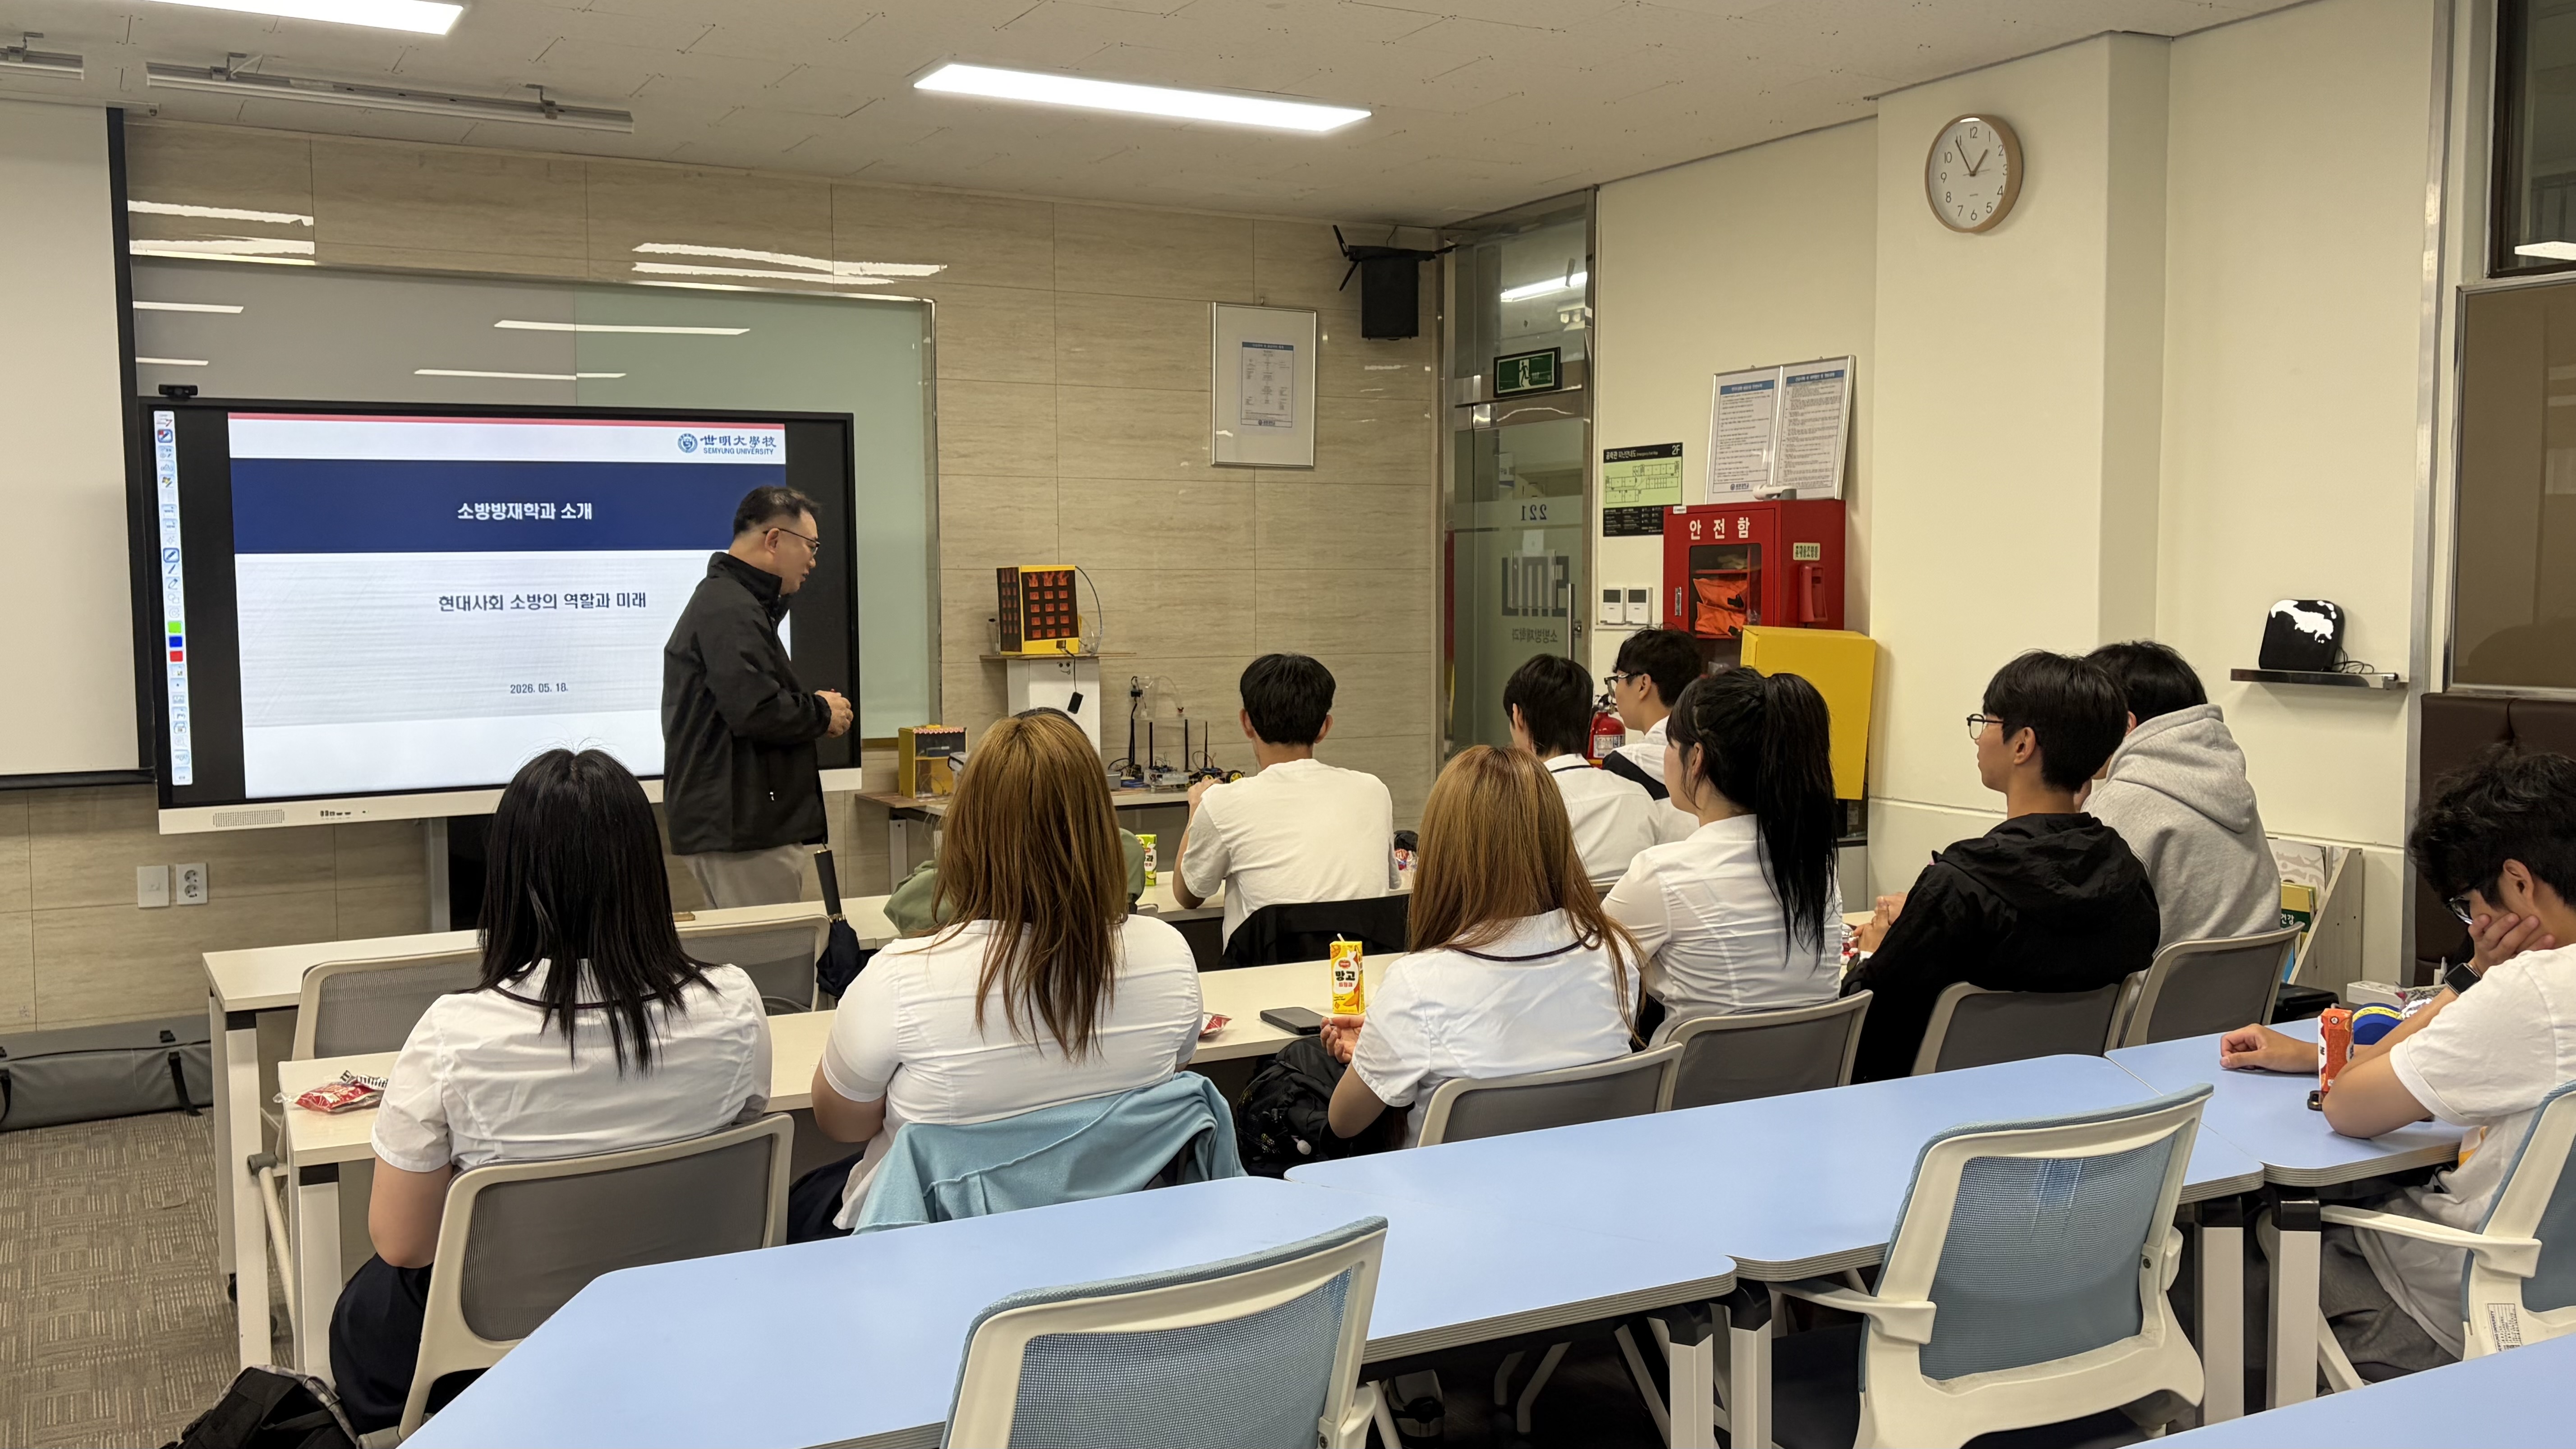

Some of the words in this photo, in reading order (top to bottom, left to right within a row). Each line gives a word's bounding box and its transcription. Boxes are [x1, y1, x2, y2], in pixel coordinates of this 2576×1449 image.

[1969, 126, 1978, 139] 12
[1998, 144, 2004, 156] 2
[1944, 152, 1953, 164] 10
[2002, 164, 2008, 176] 3
[1940, 172, 1947, 184] 9
[1996, 185, 2004, 196] 4
[1946, 191, 1952, 203] 8
[1957, 205, 1964, 217] 7
[1986, 202, 1993, 214] 5
[1970, 209, 1978, 221] 6
[1671, 444, 1681, 455] 2F
[457, 502, 556, 521] 소방방재학과
[560, 502, 593, 520] 소개
[438, 594, 504, 612] 현대사회
[510, 593, 557, 611] 소방의
[563, 593, 611, 609] 역할과
[616, 591, 647, 608] 미래
[510, 683, 536, 694] 2026.
[538, 682, 552, 693] 05.
[556, 682, 569, 692] 18.
[1335, 970, 1356, 981] 망고
